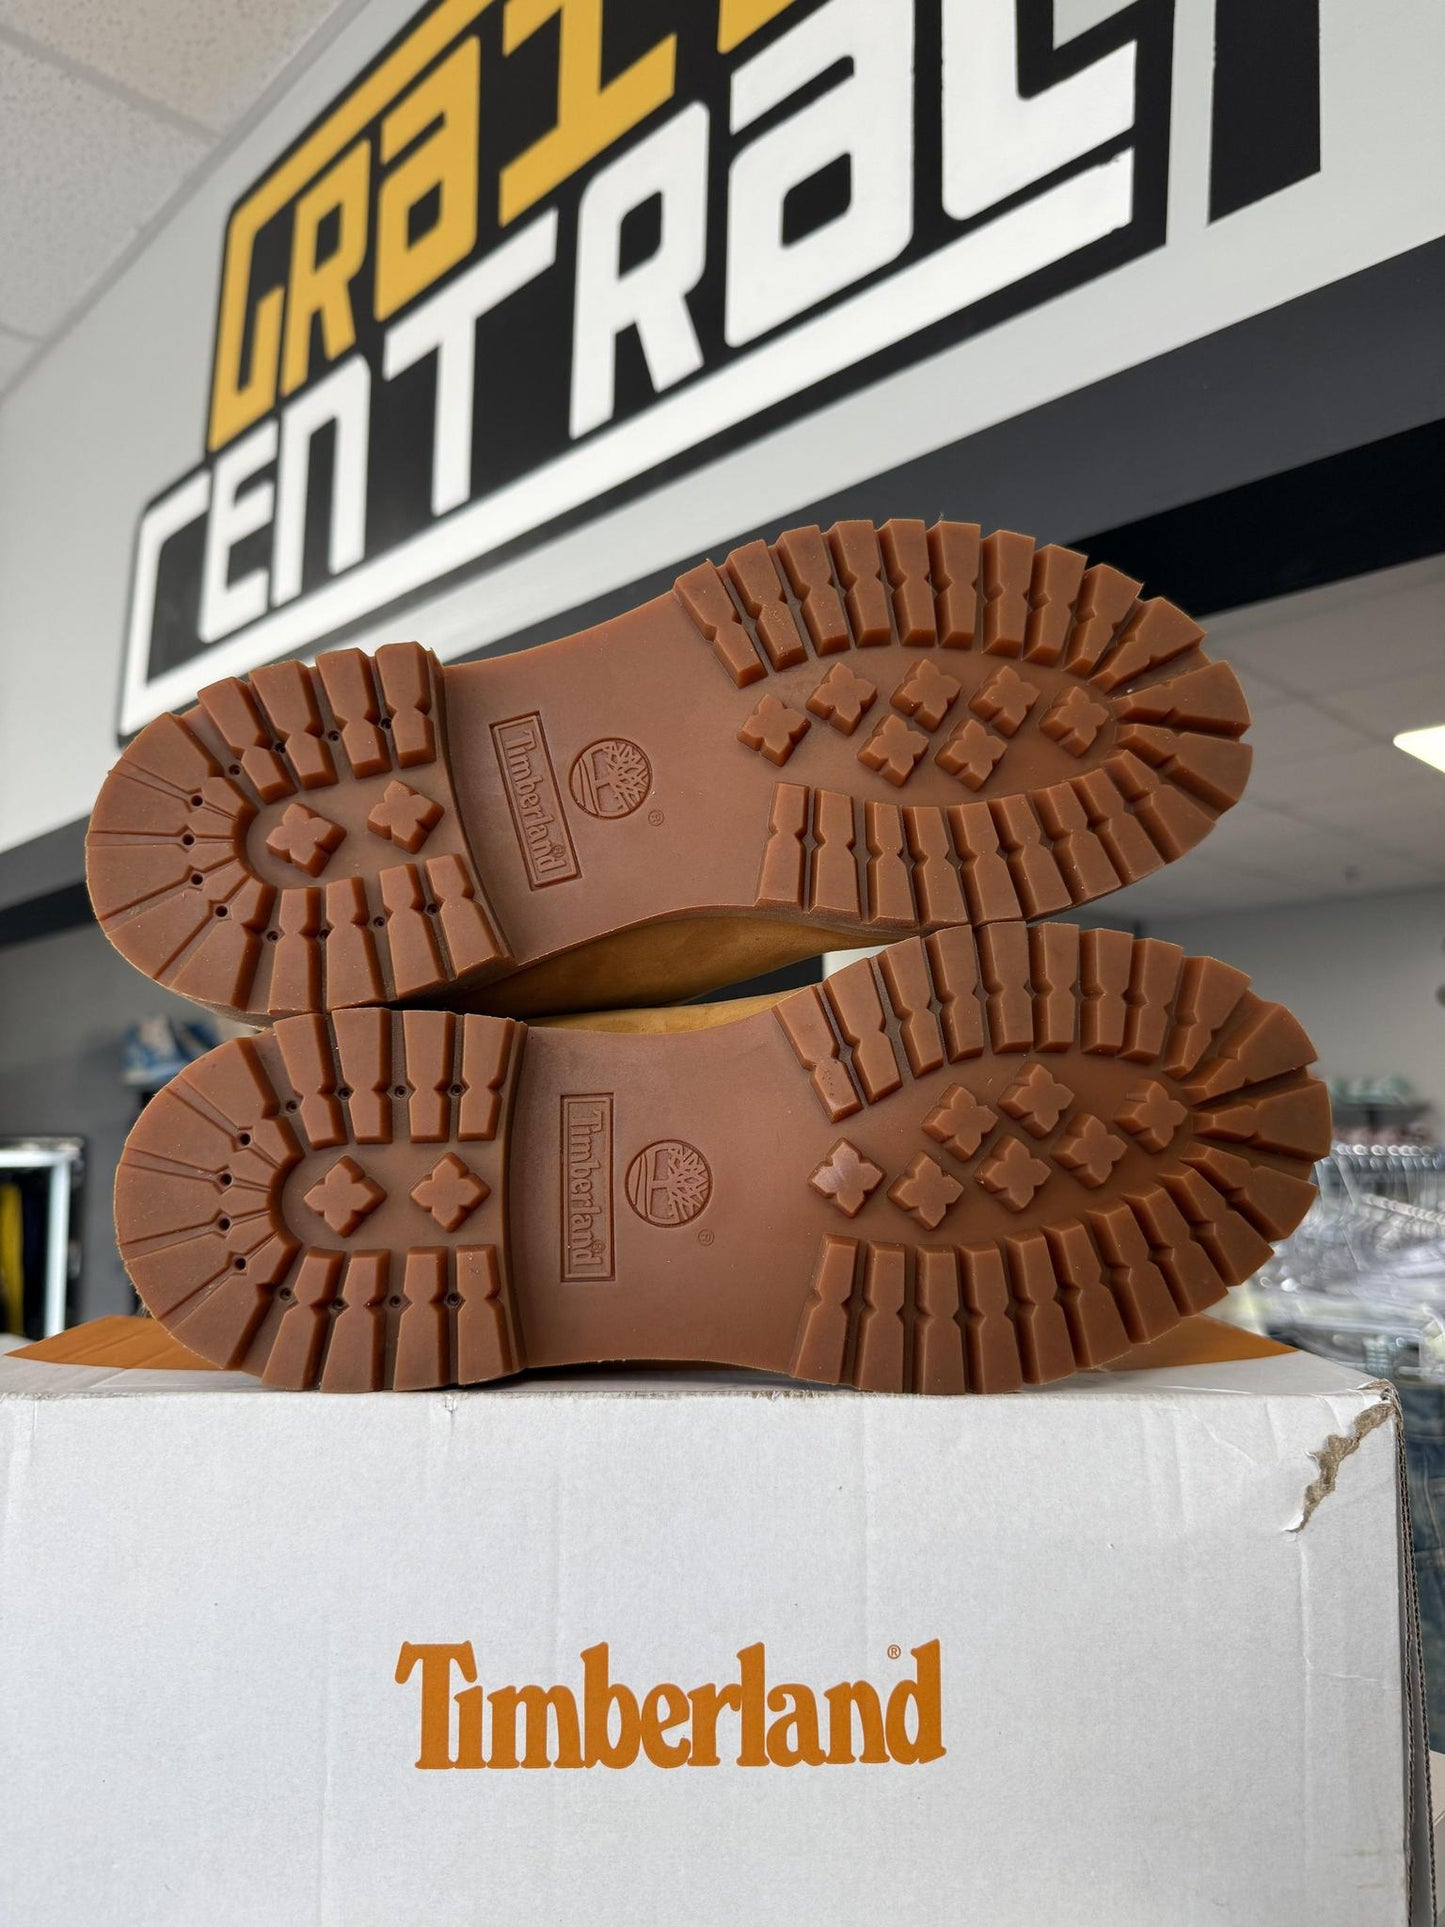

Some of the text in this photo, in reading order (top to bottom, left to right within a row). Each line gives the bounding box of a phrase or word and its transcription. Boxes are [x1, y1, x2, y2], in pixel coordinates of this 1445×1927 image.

[504, 728, 568, 874] Timberland
[569, 1109, 606, 1267] Timberland
[394, 1638, 947, 1770] Timberland
